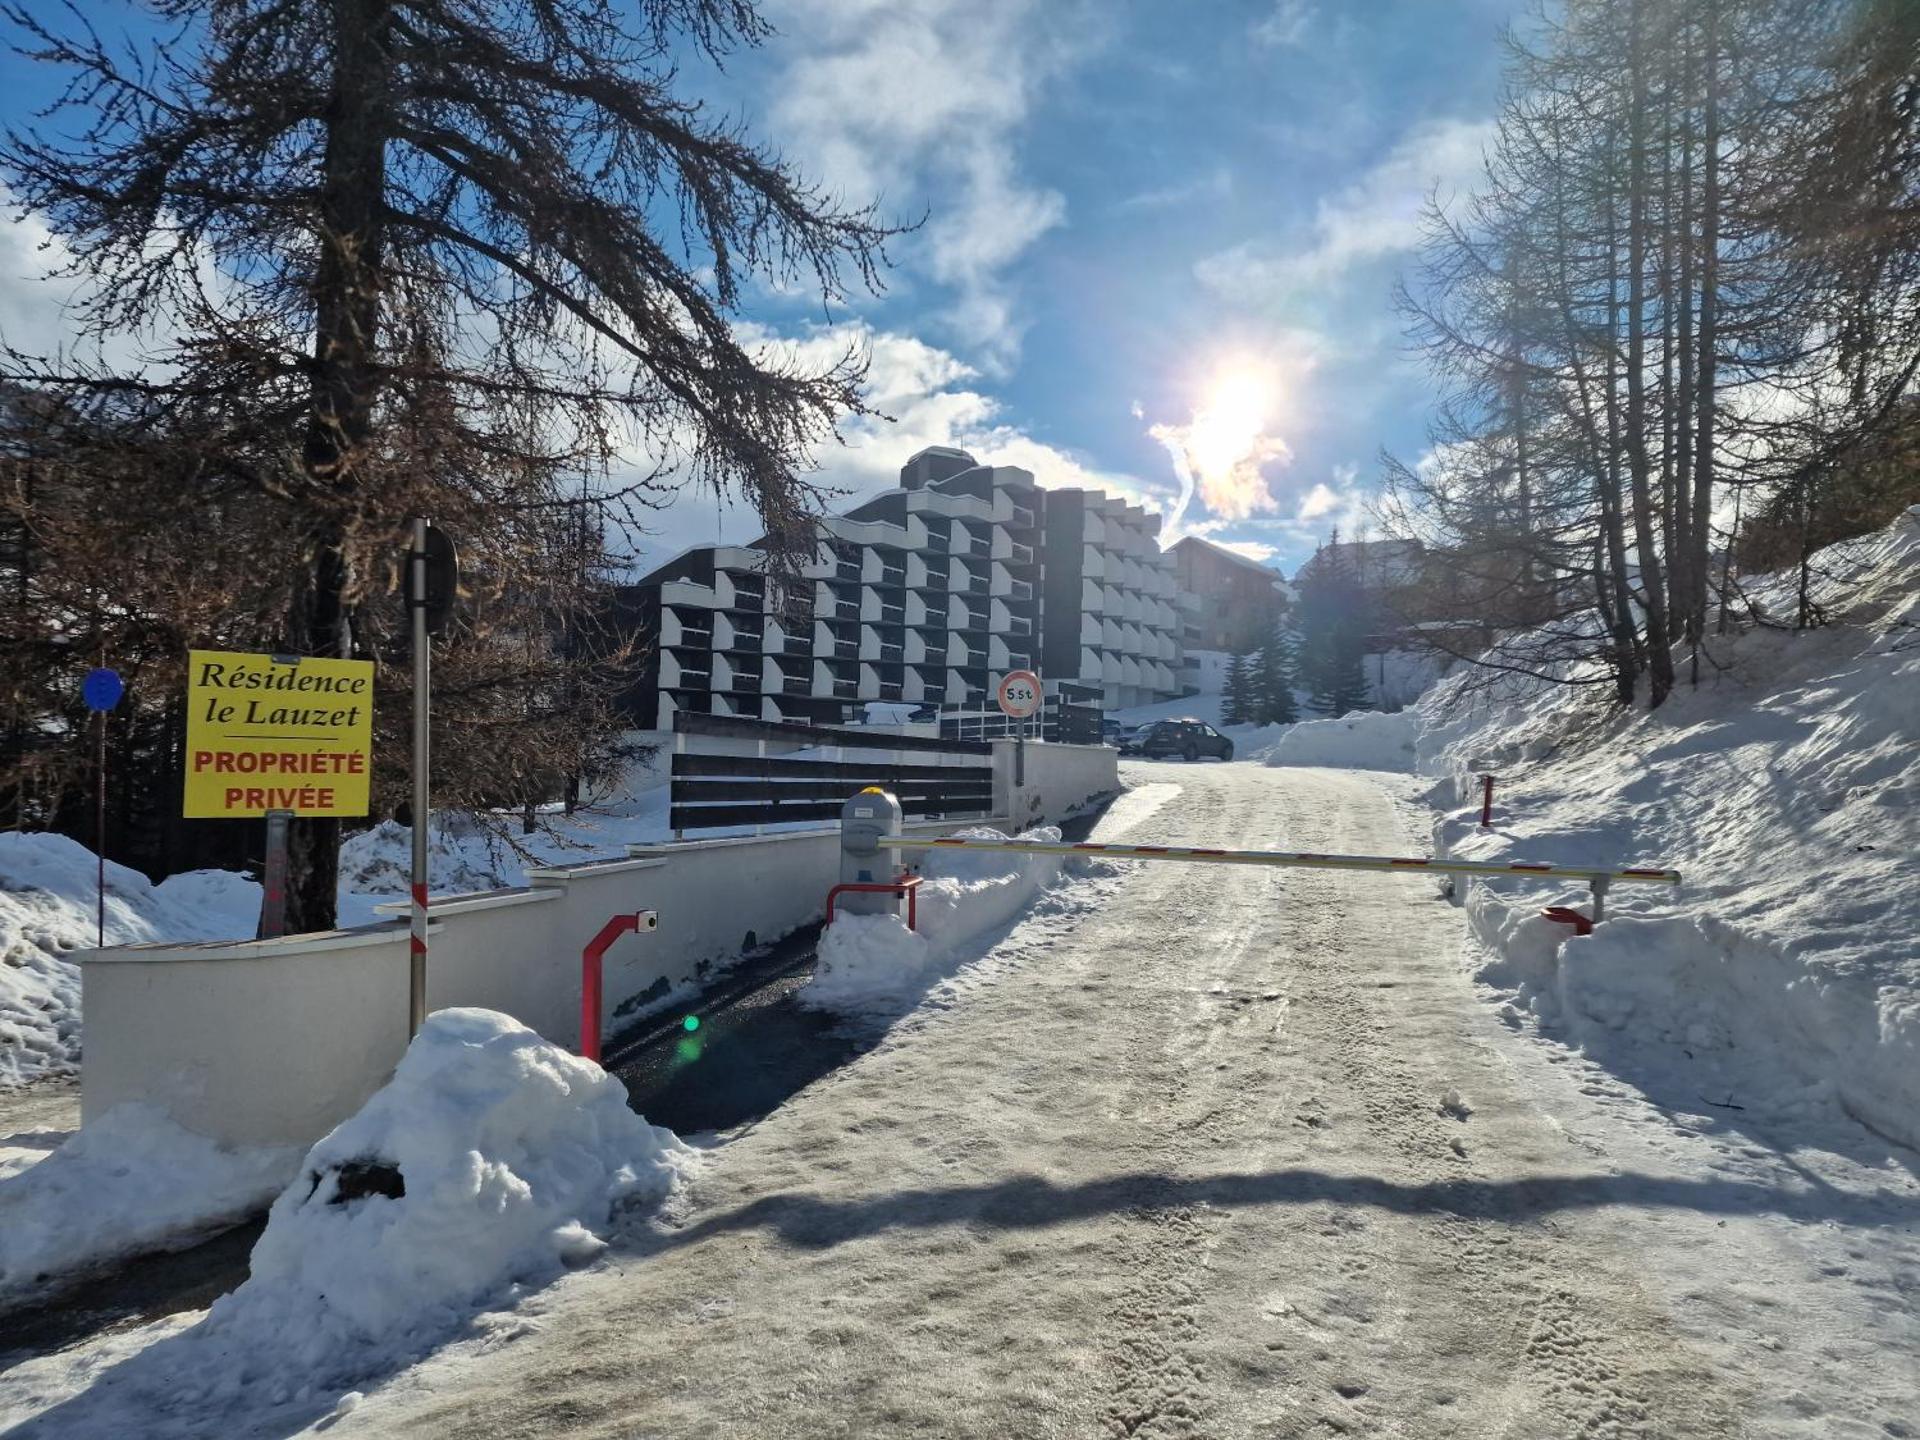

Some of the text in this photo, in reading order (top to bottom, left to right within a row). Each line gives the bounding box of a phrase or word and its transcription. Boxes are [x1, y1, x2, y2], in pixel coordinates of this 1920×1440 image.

[197, 663, 366, 694] Résidence
[205, 698, 361, 727] le Lauzet
[194, 749, 364, 774] PROPRIÉTÉ
[225, 783, 335, 809] PRIVÉE
